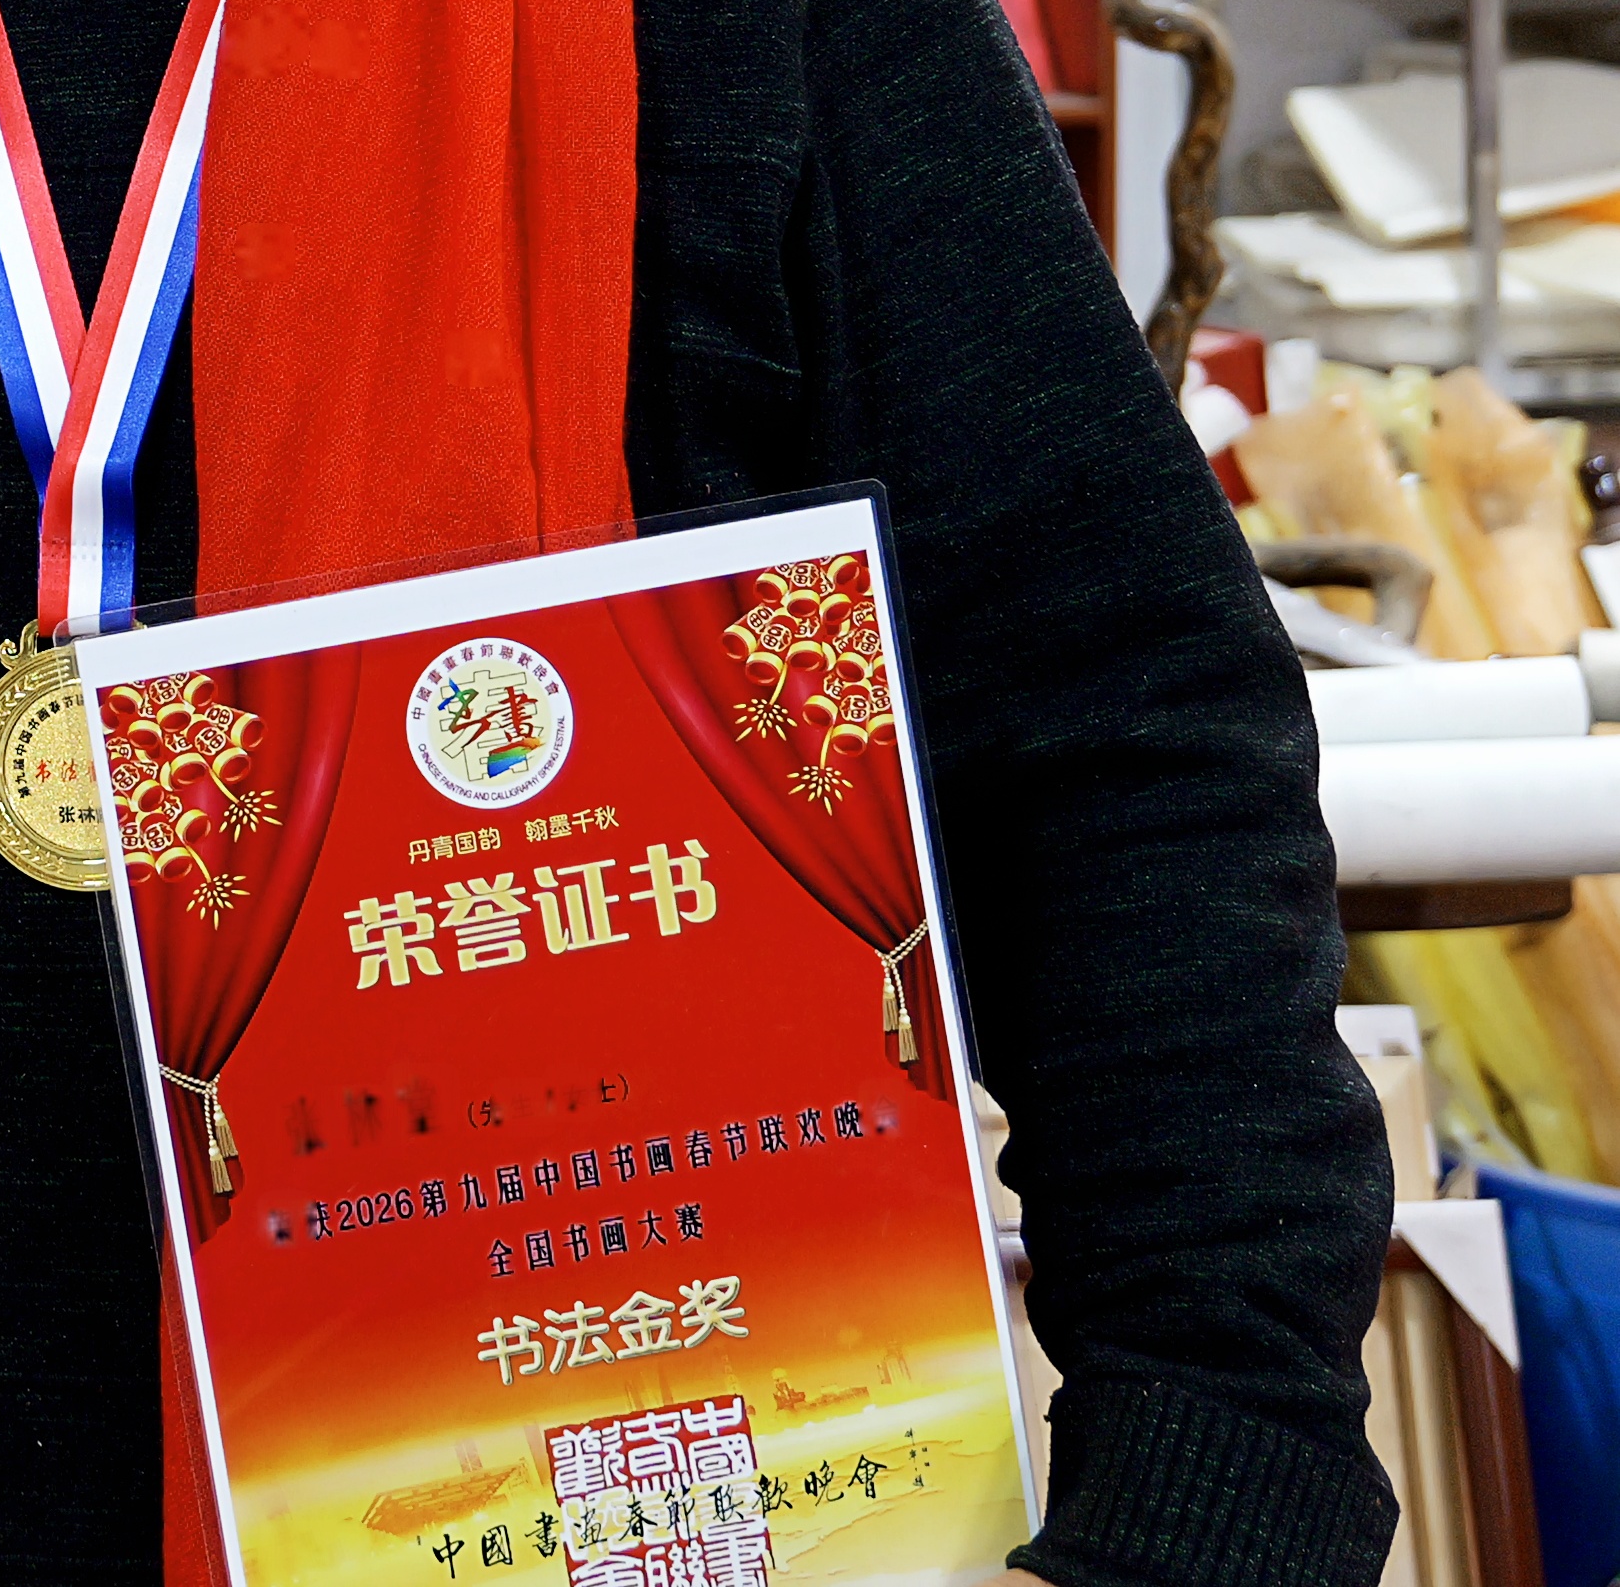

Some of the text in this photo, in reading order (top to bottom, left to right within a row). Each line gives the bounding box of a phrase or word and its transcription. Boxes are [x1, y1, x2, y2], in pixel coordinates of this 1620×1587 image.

[473, 791, 490, 801] AND
[490, 774, 539, 801] CALLIGRAPHY
[538, 751, 559, 779] SPRING
[553, 714, 566, 753] FESTIVAL
[408, 805, 620, 864] 丹青国韵 翰墨千秋
[343, 838, 717, 990] 荣誉证书
[266, 1096, 899, 1246] 获2026第九届中国书画春节联欢晚
[488, 1202, 704, 1278] 全国书画大赛
[477, 1275, 749, 1385] 书法金奖
